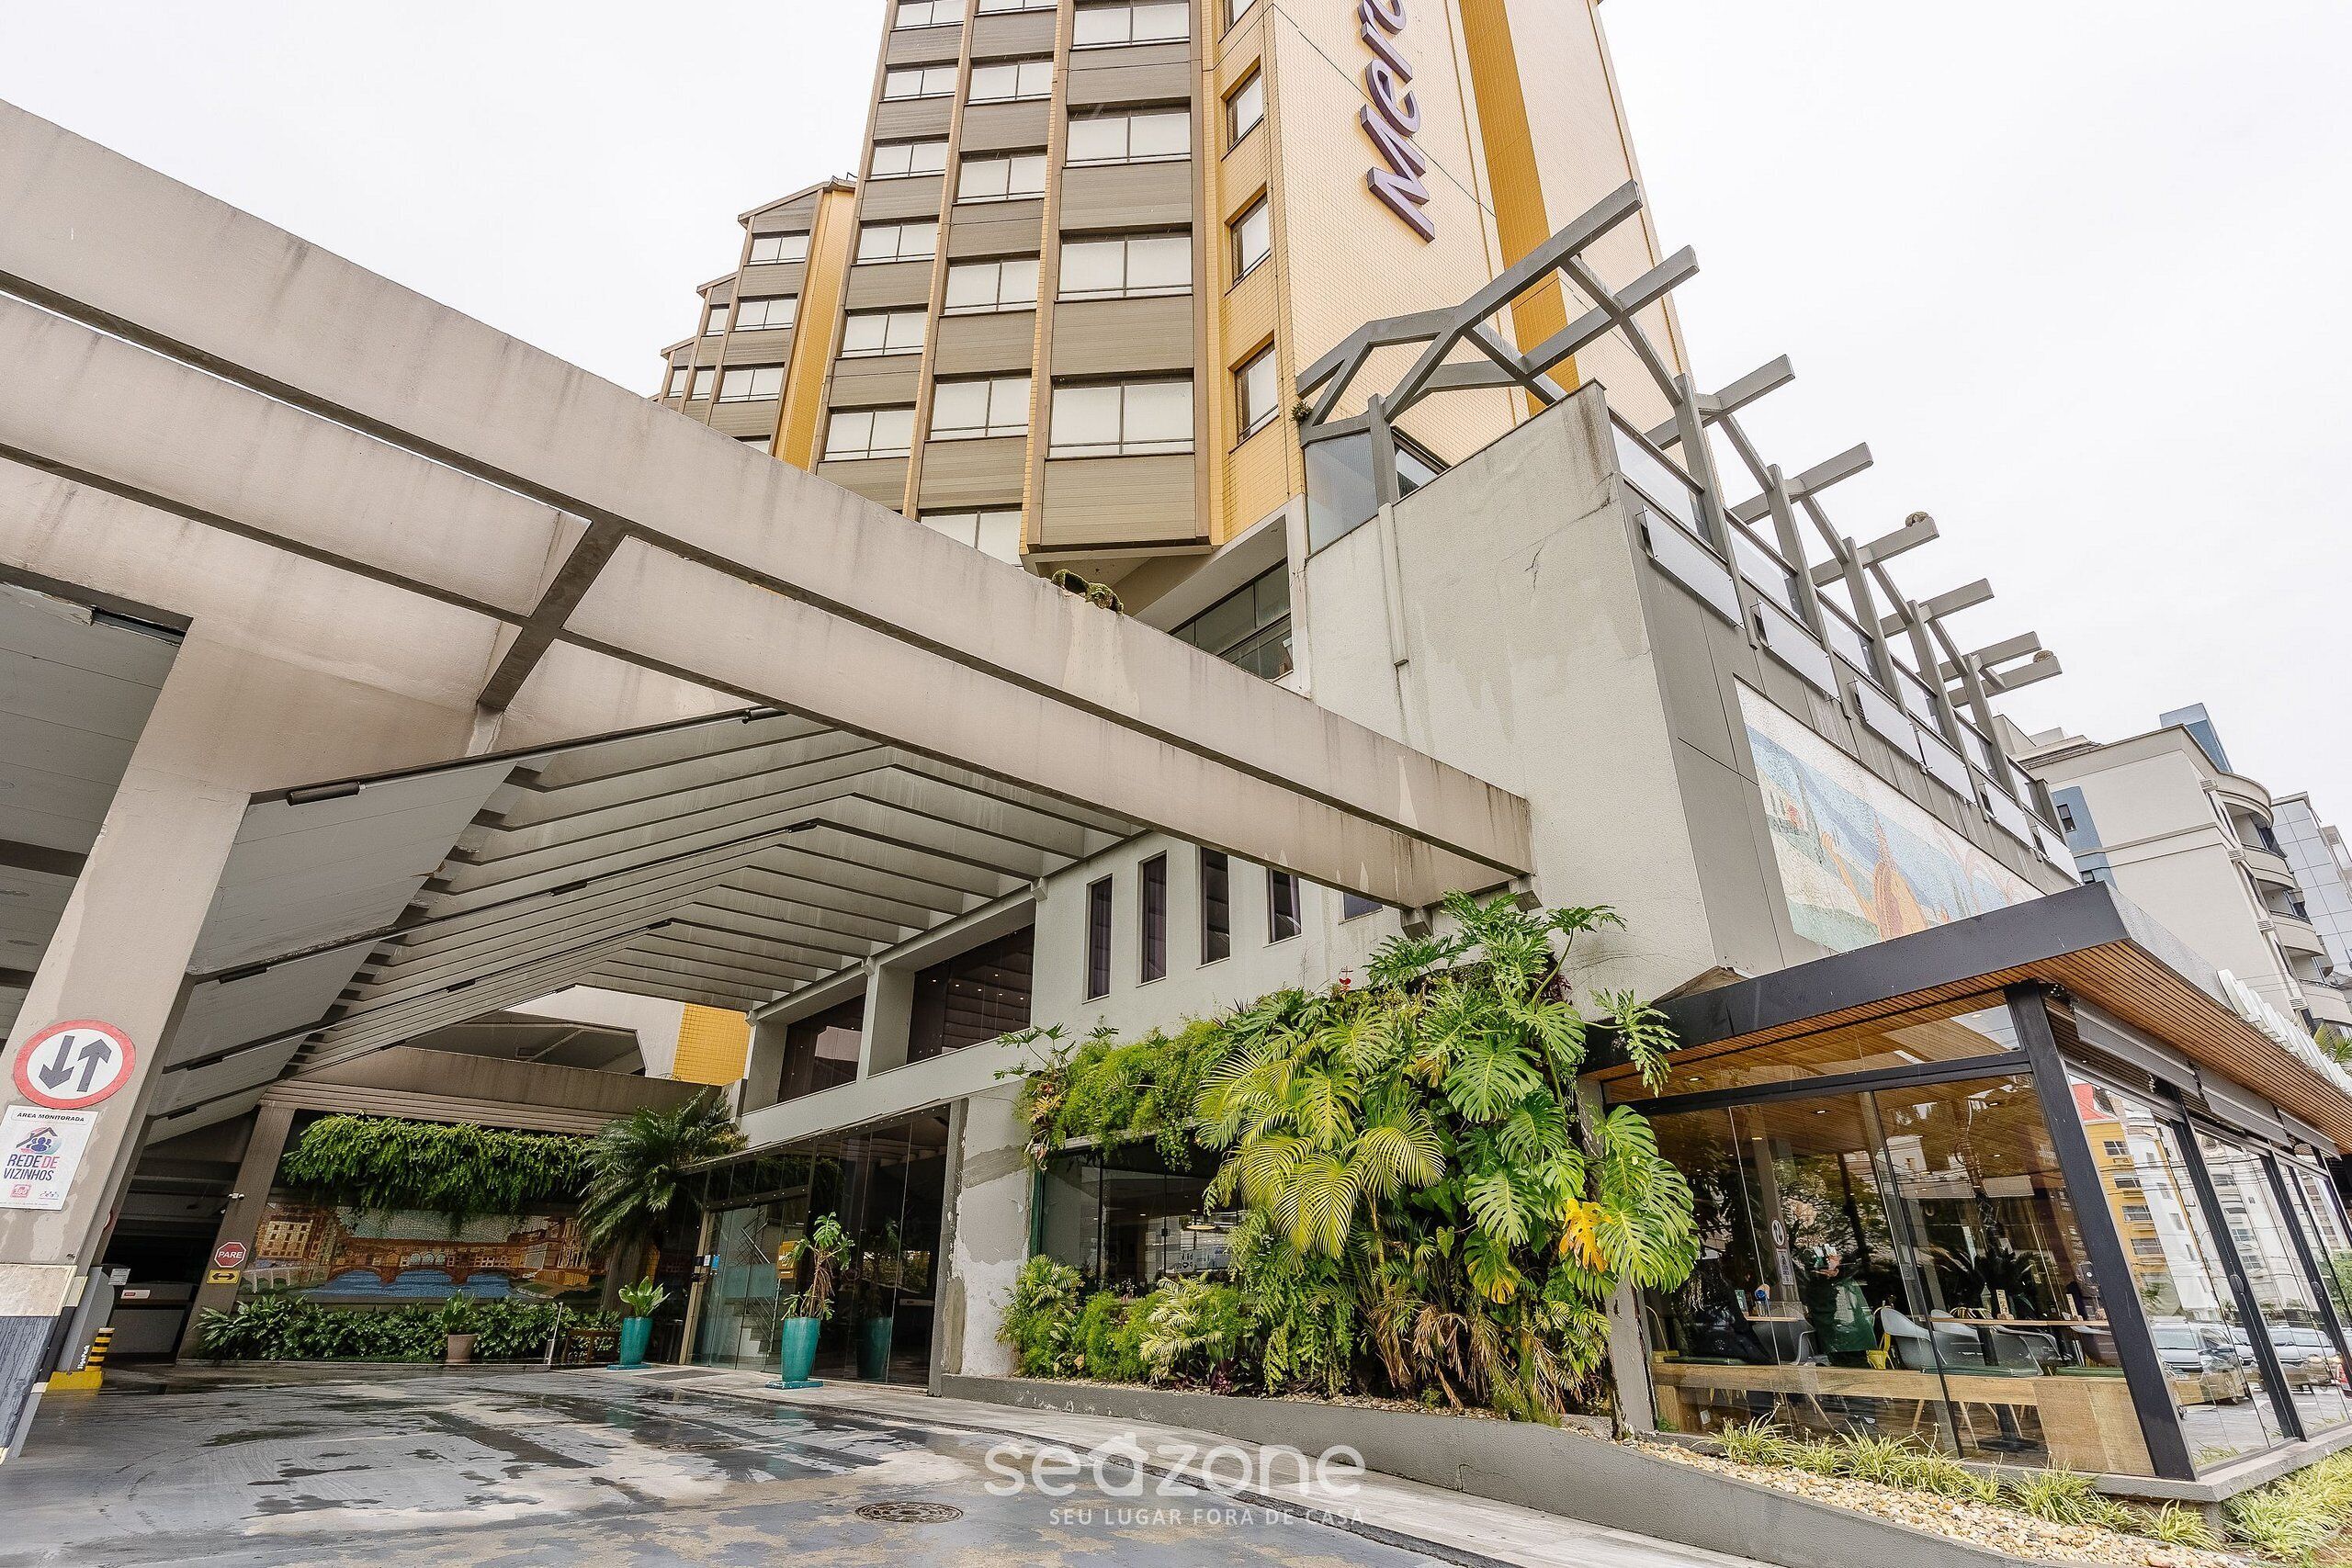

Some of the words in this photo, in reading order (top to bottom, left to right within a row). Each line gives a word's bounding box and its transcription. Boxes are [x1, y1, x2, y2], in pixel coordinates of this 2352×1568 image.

[38, 1113, 85, 1122] MONITORADA
[6, 1154, 42, 1168] REDE
[40, 1156, 61, 1169] DE
[3, 1168, 54, 1181] VIZINHOS
